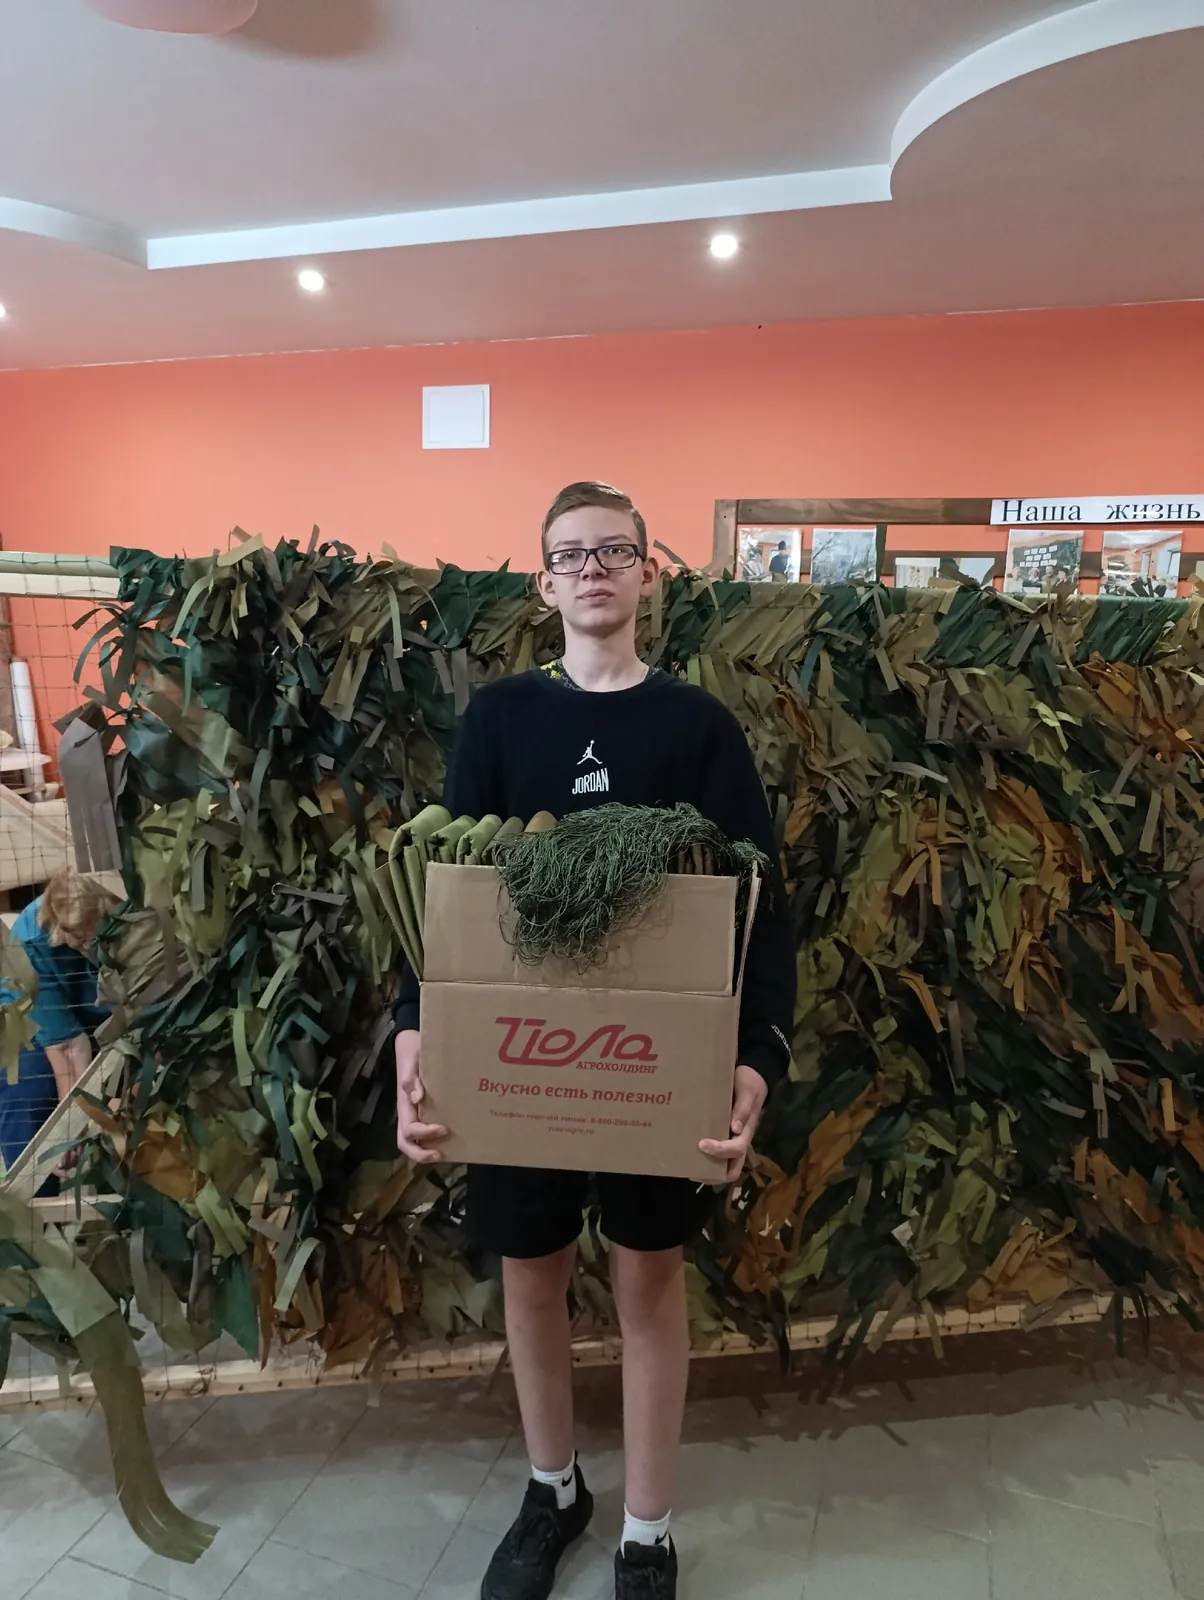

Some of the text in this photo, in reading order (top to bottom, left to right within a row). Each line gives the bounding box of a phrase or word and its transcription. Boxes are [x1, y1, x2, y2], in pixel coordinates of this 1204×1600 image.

[1001, 499, 1201, 522] Наша жизнь
[571, 767, 610, 795] JORDAN
[576, 1061, 658, 1074] АГРОХОЛДИНГ
[478, 1077, 673, 1105] Вкусно есть полезно!
